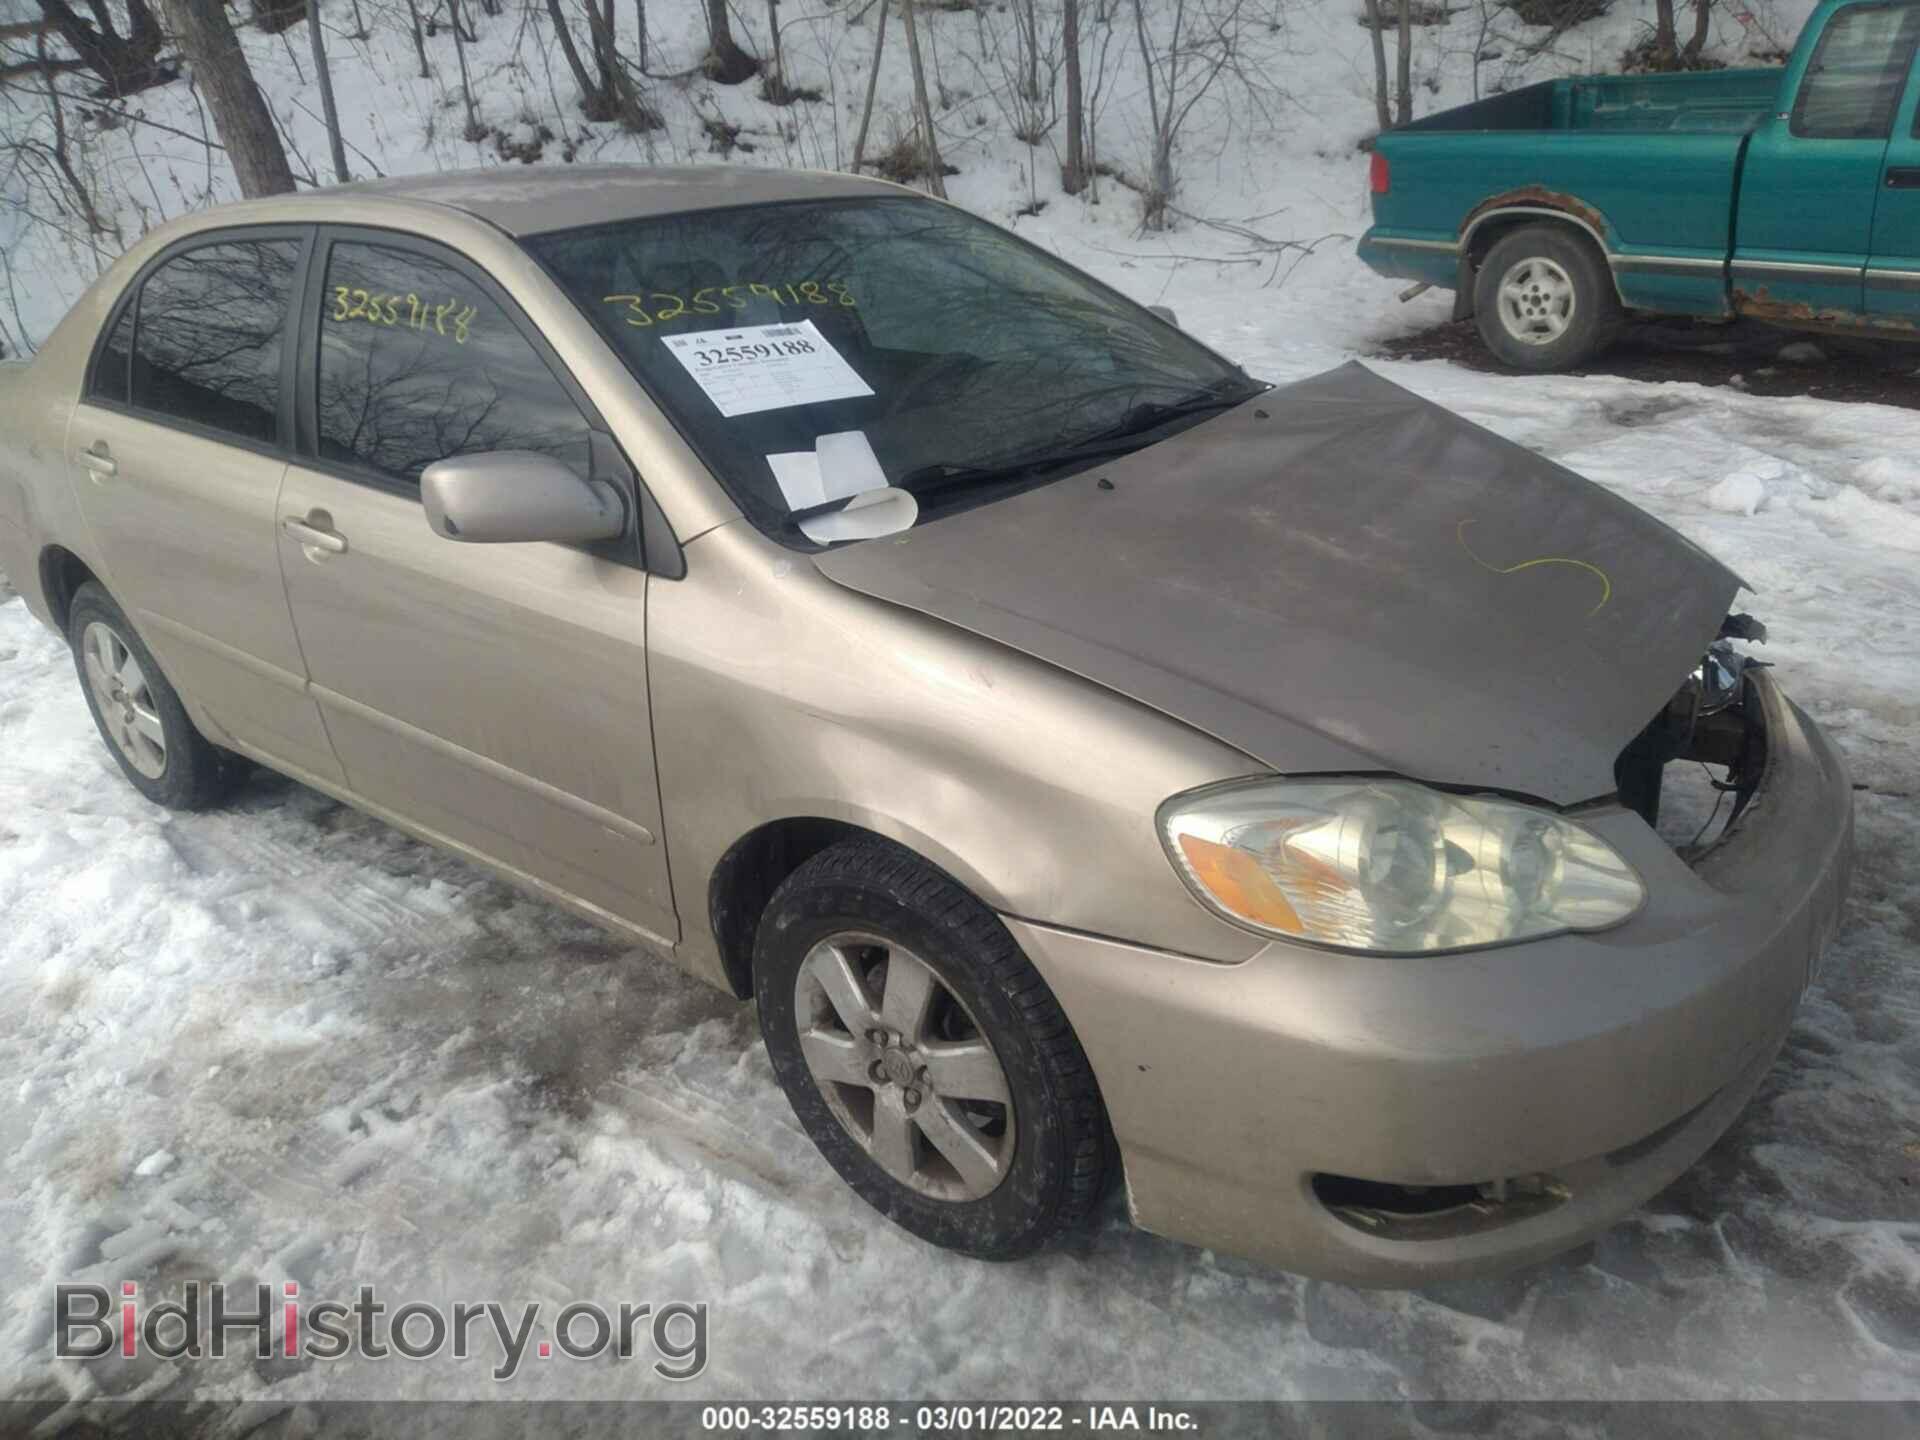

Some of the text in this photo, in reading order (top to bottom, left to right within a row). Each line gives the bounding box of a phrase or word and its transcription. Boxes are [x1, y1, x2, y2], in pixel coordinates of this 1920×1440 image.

[333, 286, 478, 344] 32559188
[603, 281, 856, 326] 32559188
[693, 339, 816, 367] 32559188
